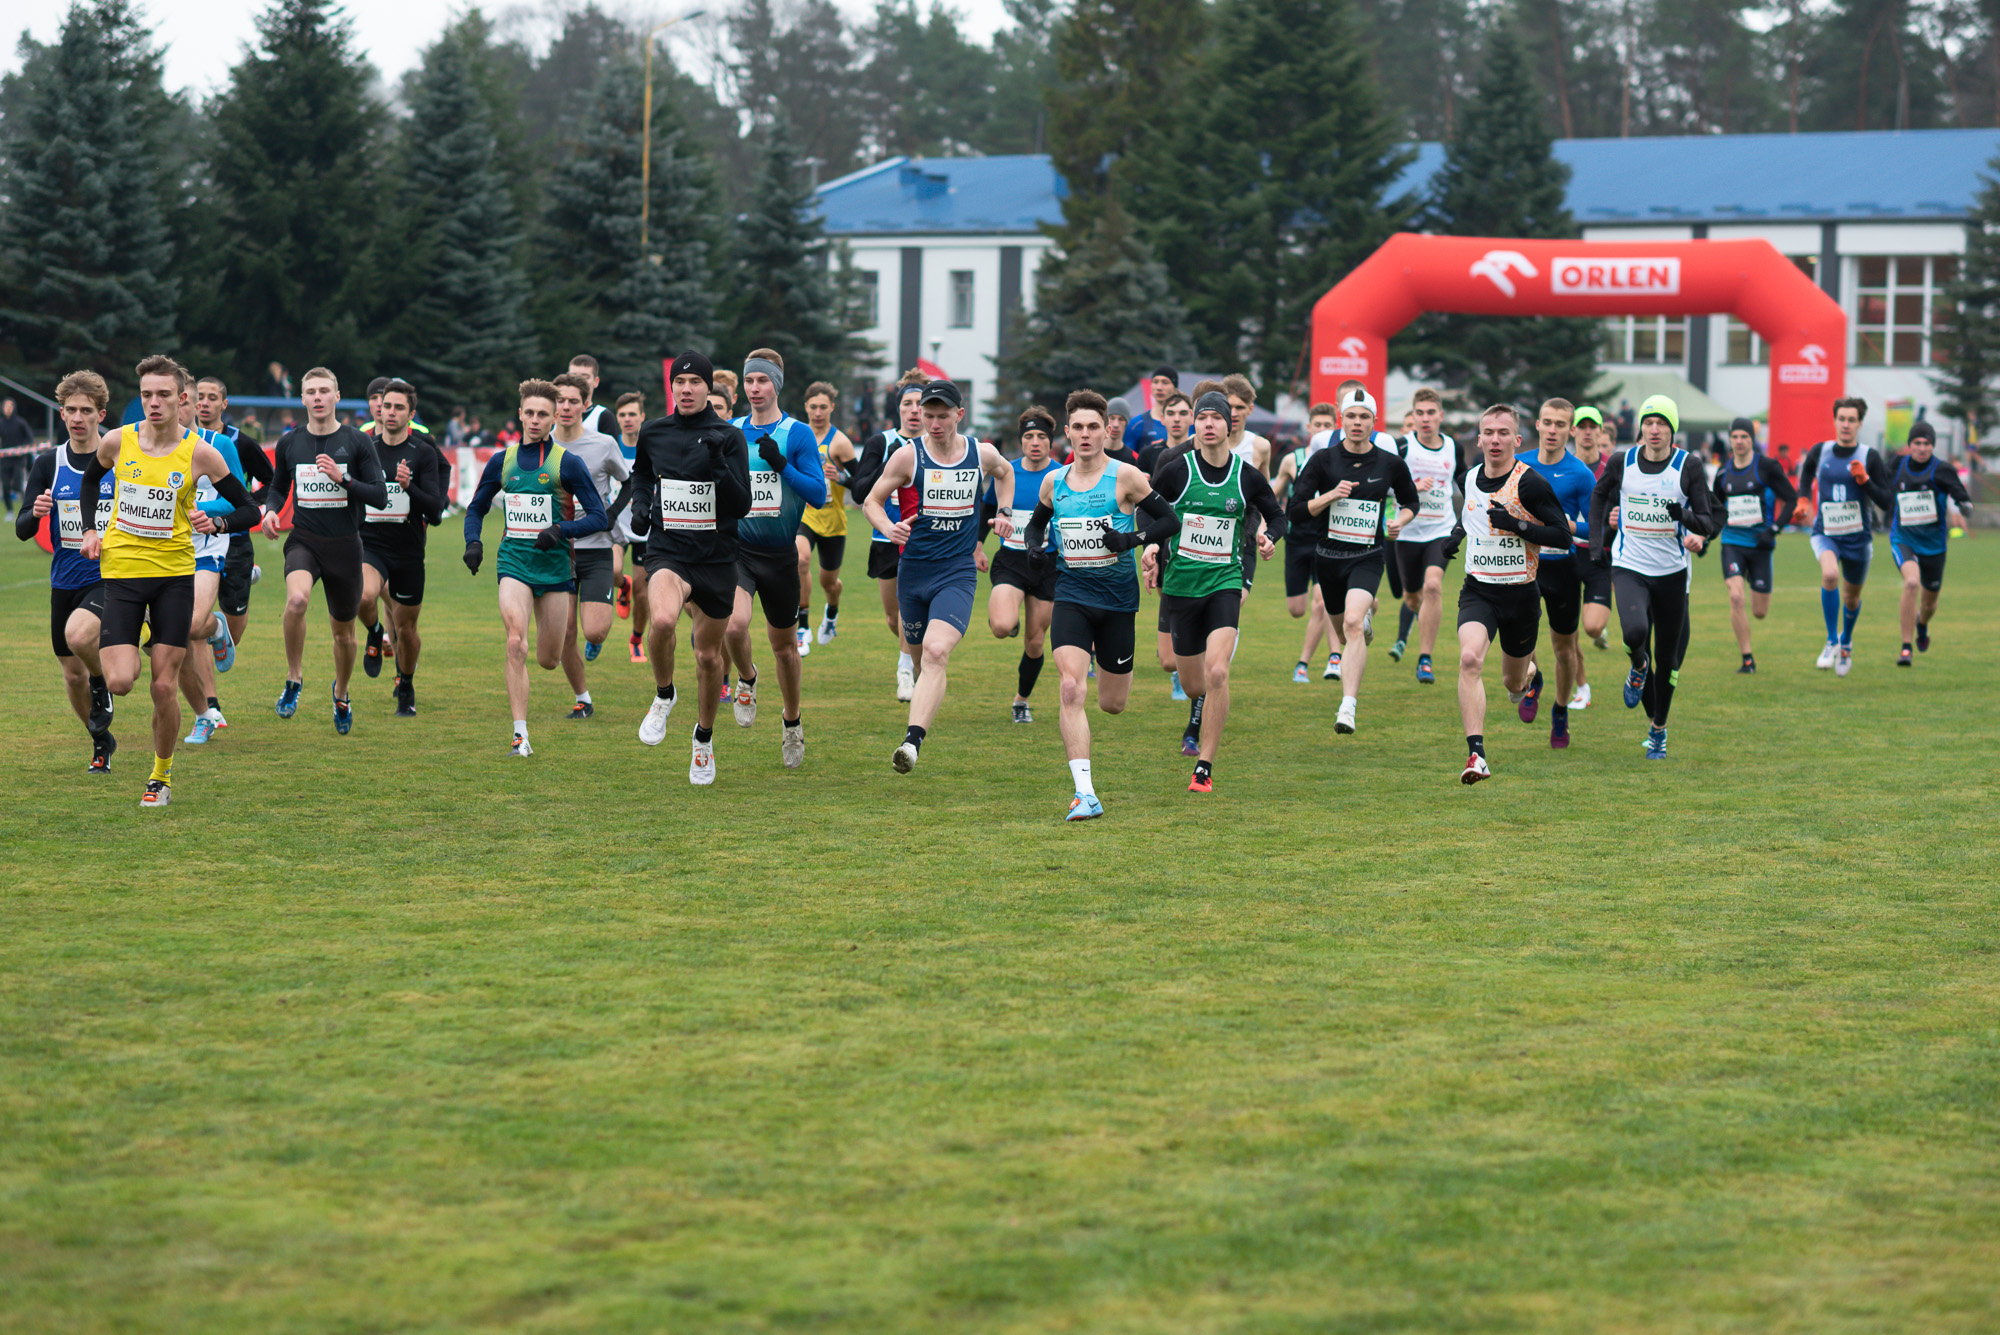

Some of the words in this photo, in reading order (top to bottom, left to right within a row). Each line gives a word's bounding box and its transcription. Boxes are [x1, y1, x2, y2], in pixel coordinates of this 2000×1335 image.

[1561, 266, 1669, 288] ORLEN
[756, 473, 778, 484] 593
[955, 471, 976, 483] 127
[303, 482, 340, 492] KOROS
[689, 484, 712, 495] 387
[1833, 484, 1846, 502] 69
[147, 488, 173, 502] 503
[753, 490, 774, 501] JDA
[927, 489, 973, 500] GIERULA
[1429, 489, 1445, 498] 425
[531, 496, 545, 507] 89
[663, 500, 711, 513] SKALSKI
[1358, 502, 1377, 513] 454
[119, 501, 173, 520] CHMIELARZ
[508, 509, 548, 523] ĆWIKŁA
[930, 517, 963, 531] ŻARY
[1332, 515, 1376, 529] WYDERKA
[1829, 513, 1856, 524] HUTNY
[1216, 519, 1230, 531] 78
[1063, 538, 1105, 550] KOMOD
[1190, 533, 1223, 547] KUNA
[1499, 537, 1522, 549] 451
[1473, 554, 1525, 566] ROMBERG
